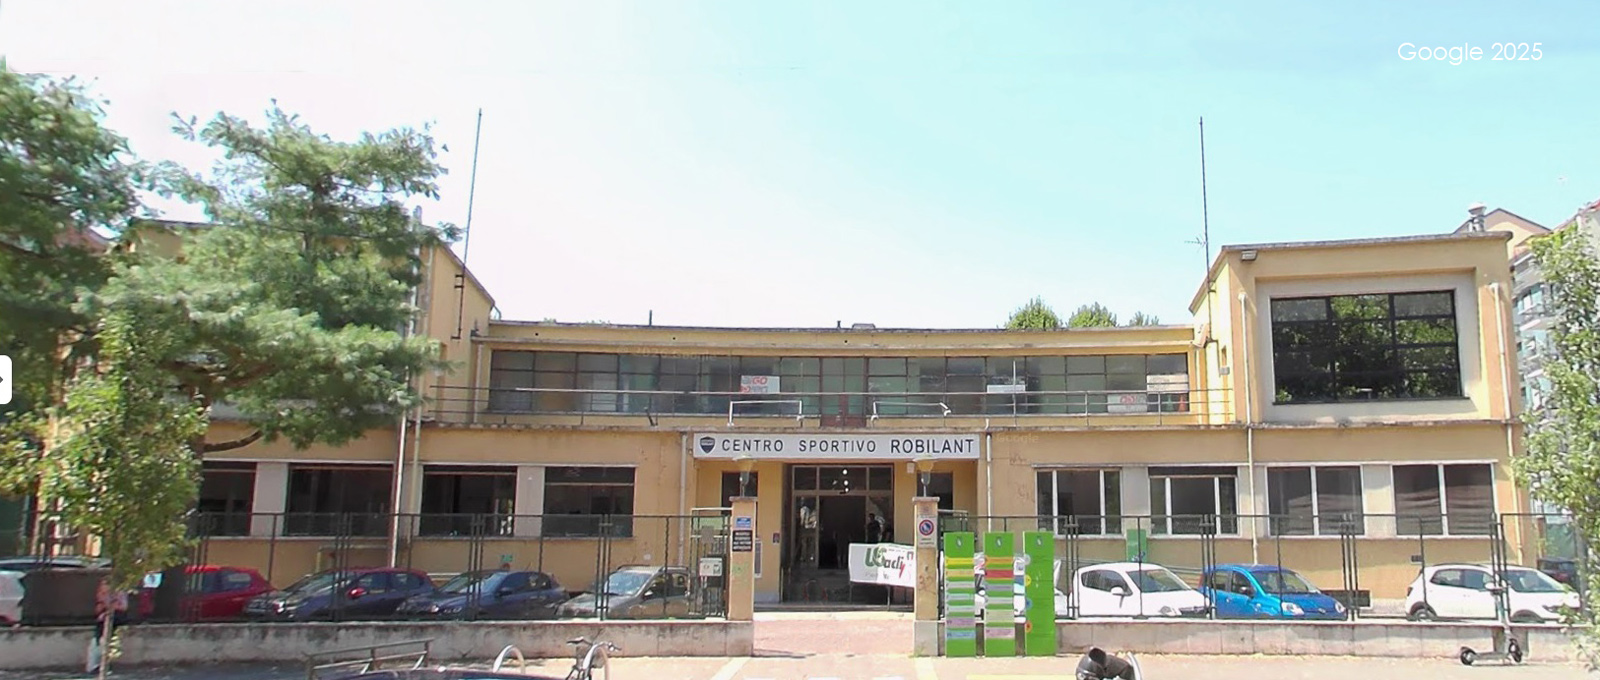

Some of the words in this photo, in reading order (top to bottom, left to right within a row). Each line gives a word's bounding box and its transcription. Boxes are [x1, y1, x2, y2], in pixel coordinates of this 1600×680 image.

[721, 439, 784, 452] CENTRO
[798, 439, 877, 453] SPORTIVO
[890, 438, 975, 454] ROBILANT
